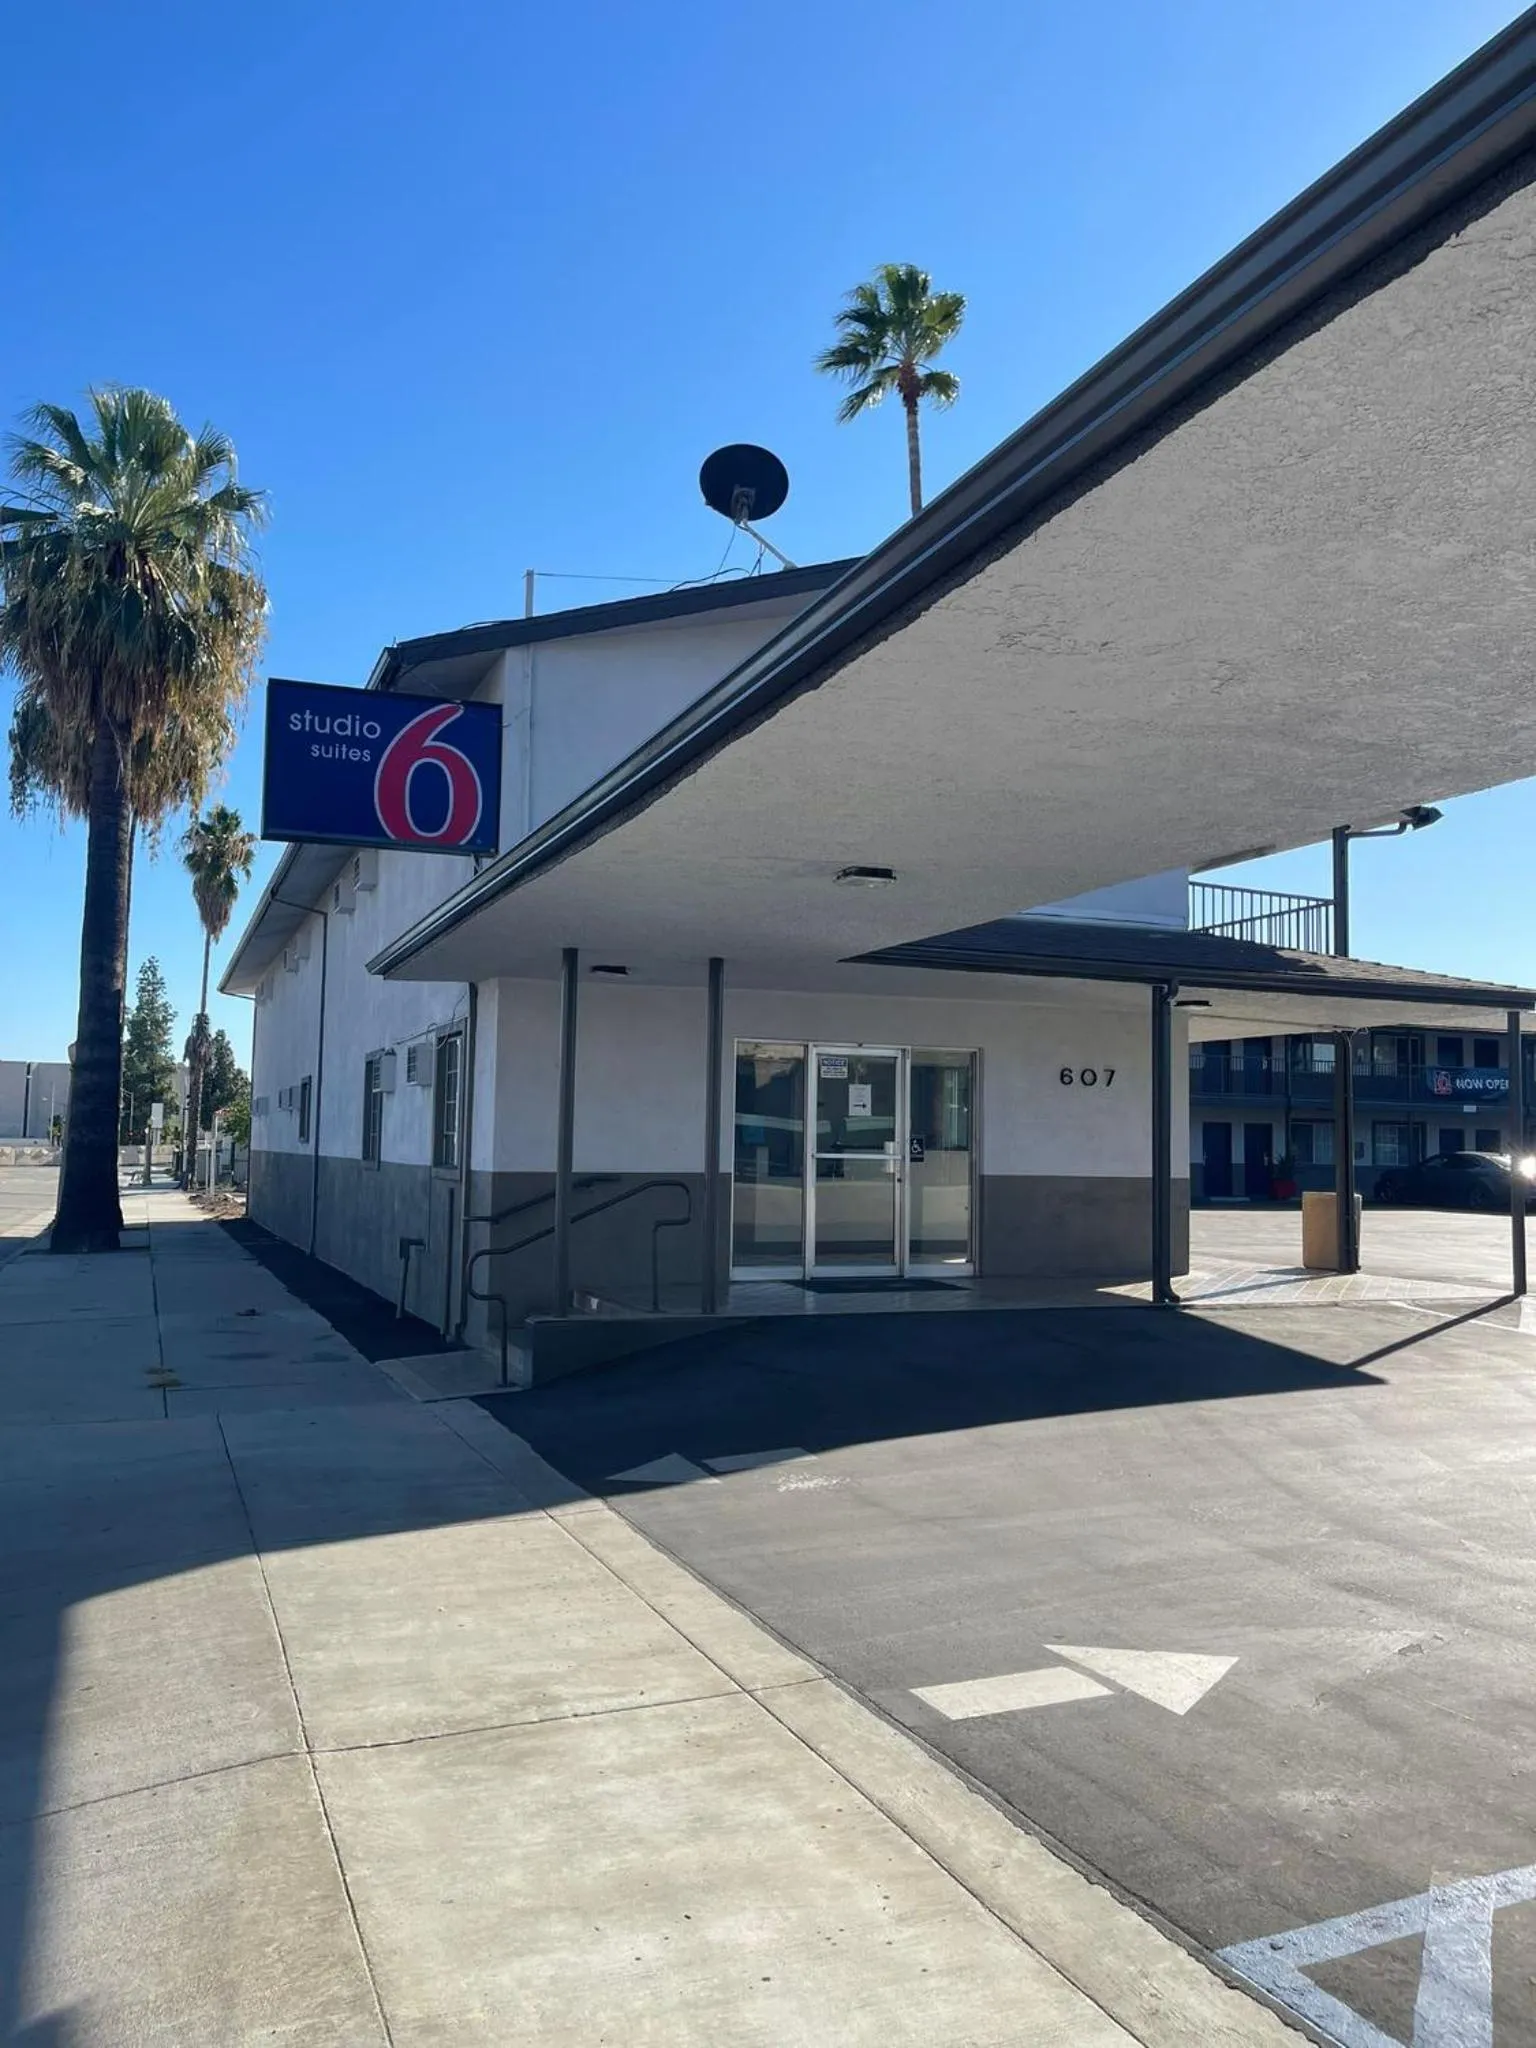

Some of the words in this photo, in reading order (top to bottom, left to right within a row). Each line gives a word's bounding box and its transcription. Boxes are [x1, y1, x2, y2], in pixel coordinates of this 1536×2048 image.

[289, 710, 381, 739] studio
[310, 743, 371, 762] suites
[374, 703, 482, 845] 6
[1060, 1068, 1116, 1087] 607
[1456, 1078, 1483, 1089] NOW
